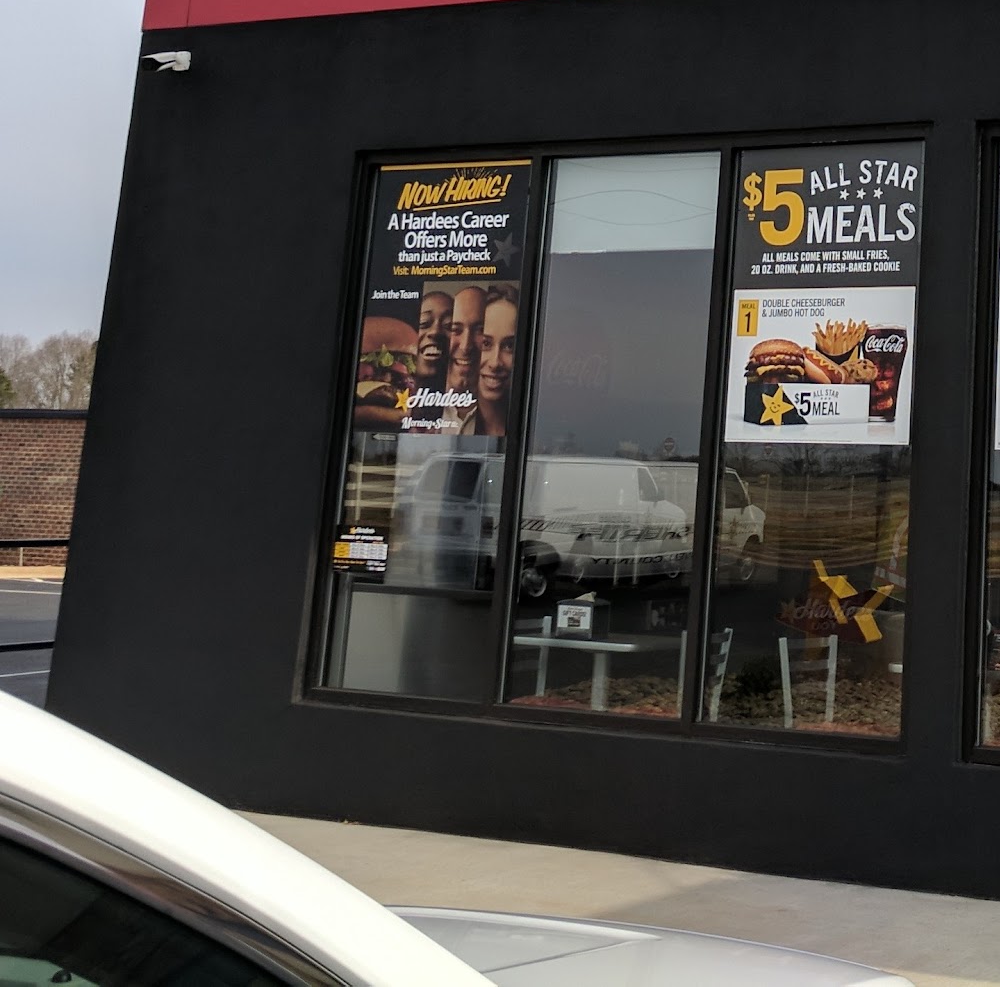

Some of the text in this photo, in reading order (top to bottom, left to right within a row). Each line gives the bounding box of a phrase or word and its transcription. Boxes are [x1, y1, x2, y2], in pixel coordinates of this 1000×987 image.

[397, 174, 512, 210] NOW HIRING!
[742, 159, 918, 246] $5 ALL STAR
[388, 211, 510, 231] A Hardees Career
[806, 202, 916, 244] MEALS
[404, 230, 488, 249] Offers More
[398, 249, 491, 265] than just a Paycheck
[762, 250, 890, 262] ALL MEALS COME WITH SMALL FRIES,
[393, 265, 496, 277] Visit: MorningStarTeam.com
[751, 261, 900, 275] 20 OZ. DRINK, AND A FRESH-BAKED COOKIE
[371, 290, 420, 300] Join the Team
[762, 298, 845, 308] DOUBLE CHEESEBURGER
[745, 312, 751, 332] 1
[762, 308, 825, 317] & JUMBO HOT DOG
[865, 334, 905, 353] Coca-Cola
[406, 388, 477, 408] Hardee's
[794, 389, 840, 416] $5 ALL STAR
[812, 401, 840, 416] MEAL
